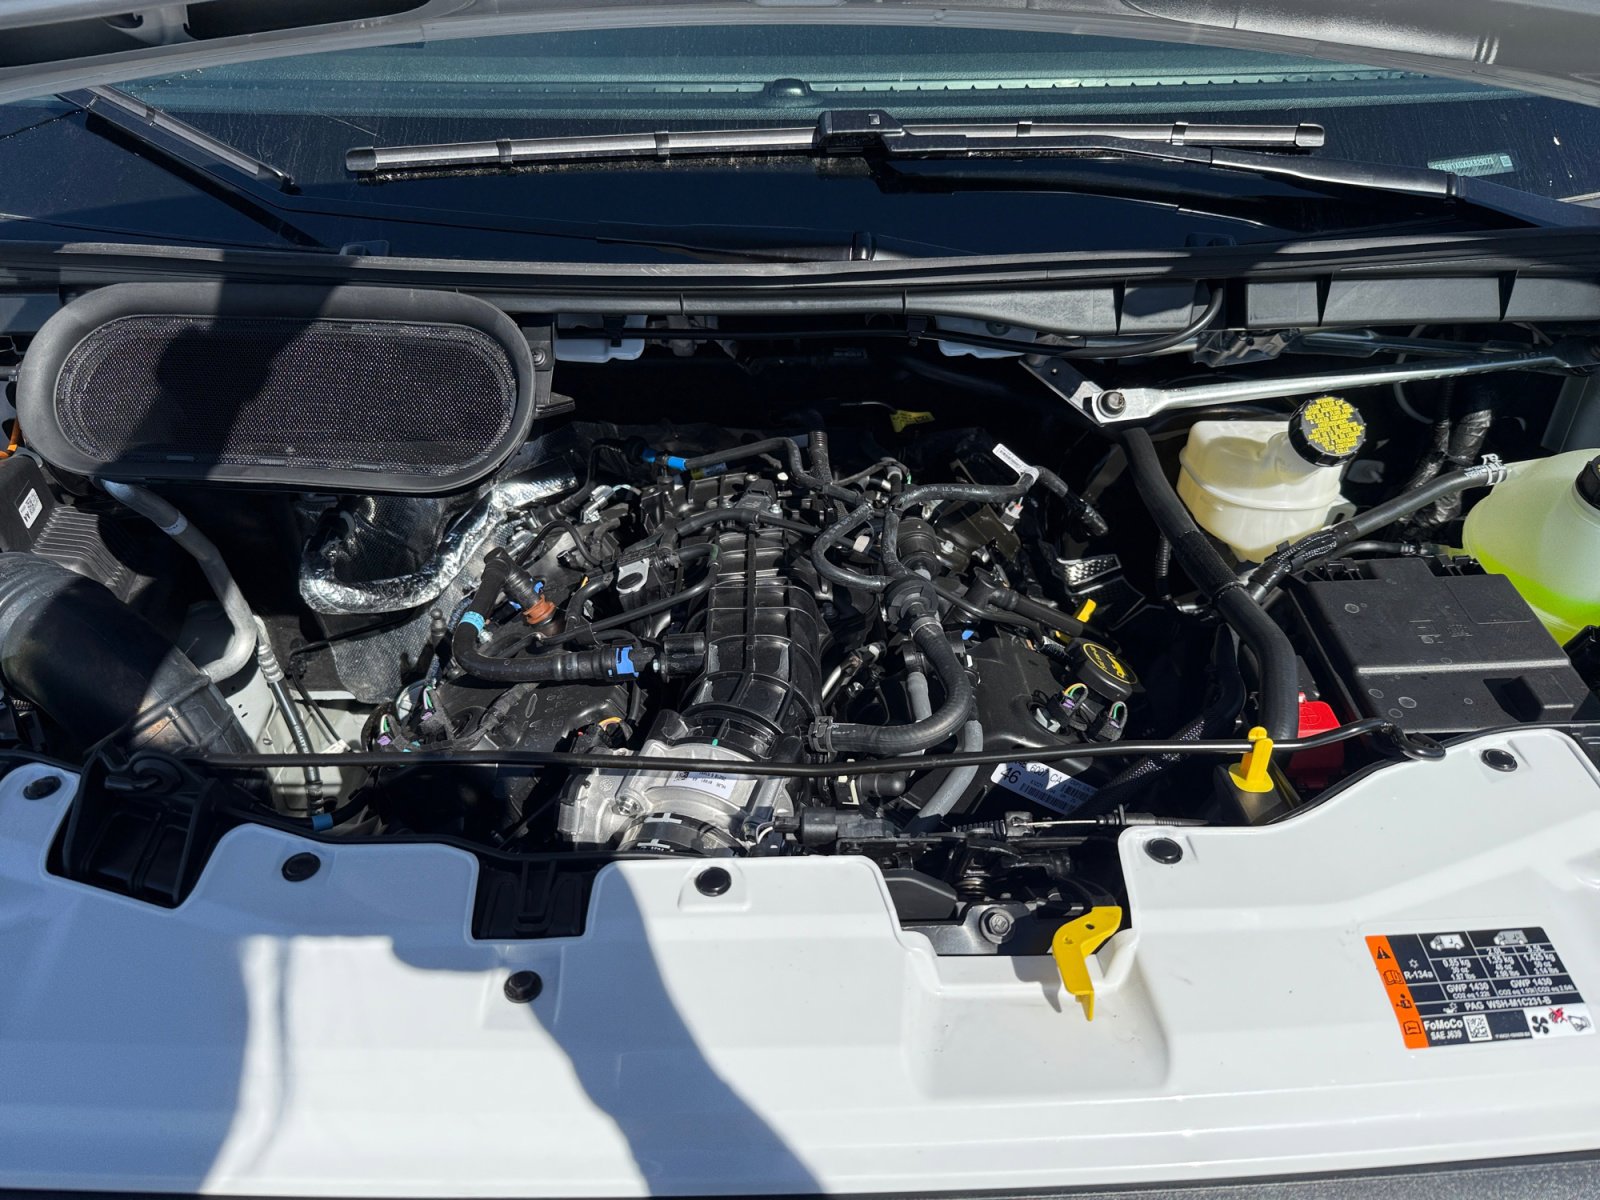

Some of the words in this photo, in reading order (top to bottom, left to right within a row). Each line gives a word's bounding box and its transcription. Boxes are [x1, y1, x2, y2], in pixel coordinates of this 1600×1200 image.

[1000, 767, 1022, 784] 46
[1403, 970, 1433, 980] R-134a
[1446, 983, 1467, 993] GWP
[1469, 982, 1489, 991] 1430
[1510, 979, 1530, 988] GWP
[1532, 977, 1552, 987] 1430
[1464, 1001, 1485, 1011] PAG
[1424, 1018, 1464, 1031] FoMoCo
[1430, 1031, 1446, 1040] SAE
